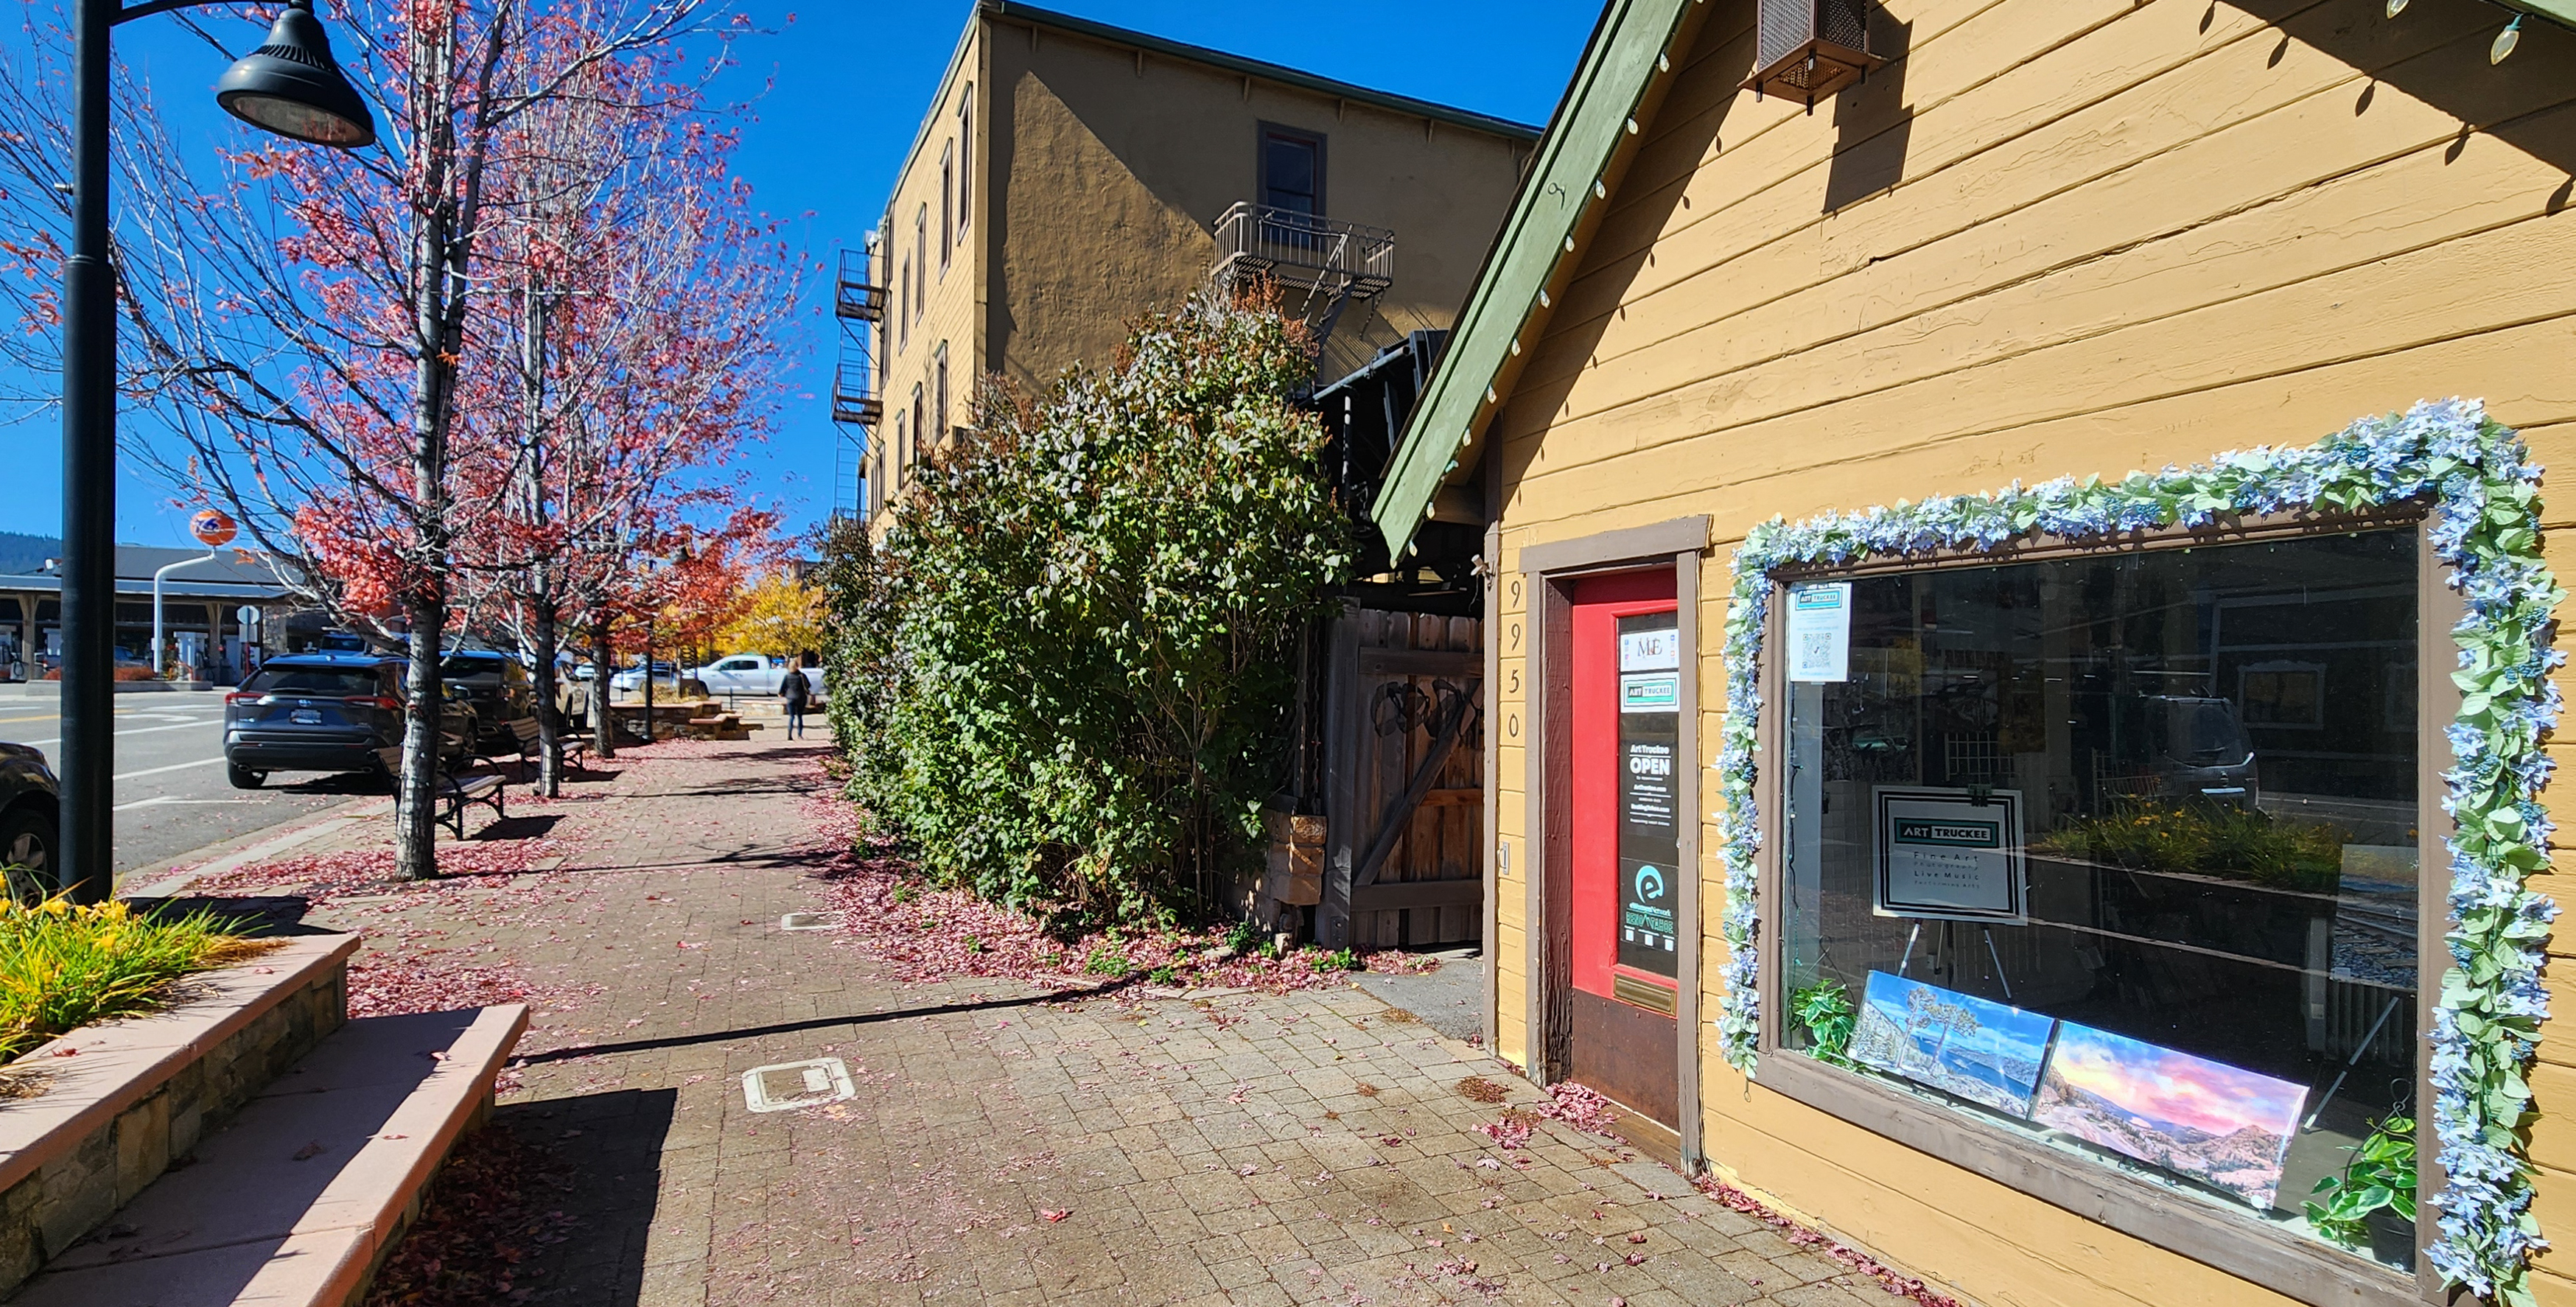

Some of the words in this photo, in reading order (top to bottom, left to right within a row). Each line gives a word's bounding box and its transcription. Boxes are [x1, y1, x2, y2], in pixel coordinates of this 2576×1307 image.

[1629, 687, 1642, 696] ART
[1631, 744, 1642, 753] Art
[1630, 757, 1670, 775] OPEN
[1903, 827, 1928, 838] ART
[1934, 828, 1988, 838] TRUCKEE
[1914, 852, 1946, 861] Fine
[1954, 854, 1978, 862] Art
[1944, 872, 1978, 880] Music
[1647, 917, 1673, 933] TAHOE
